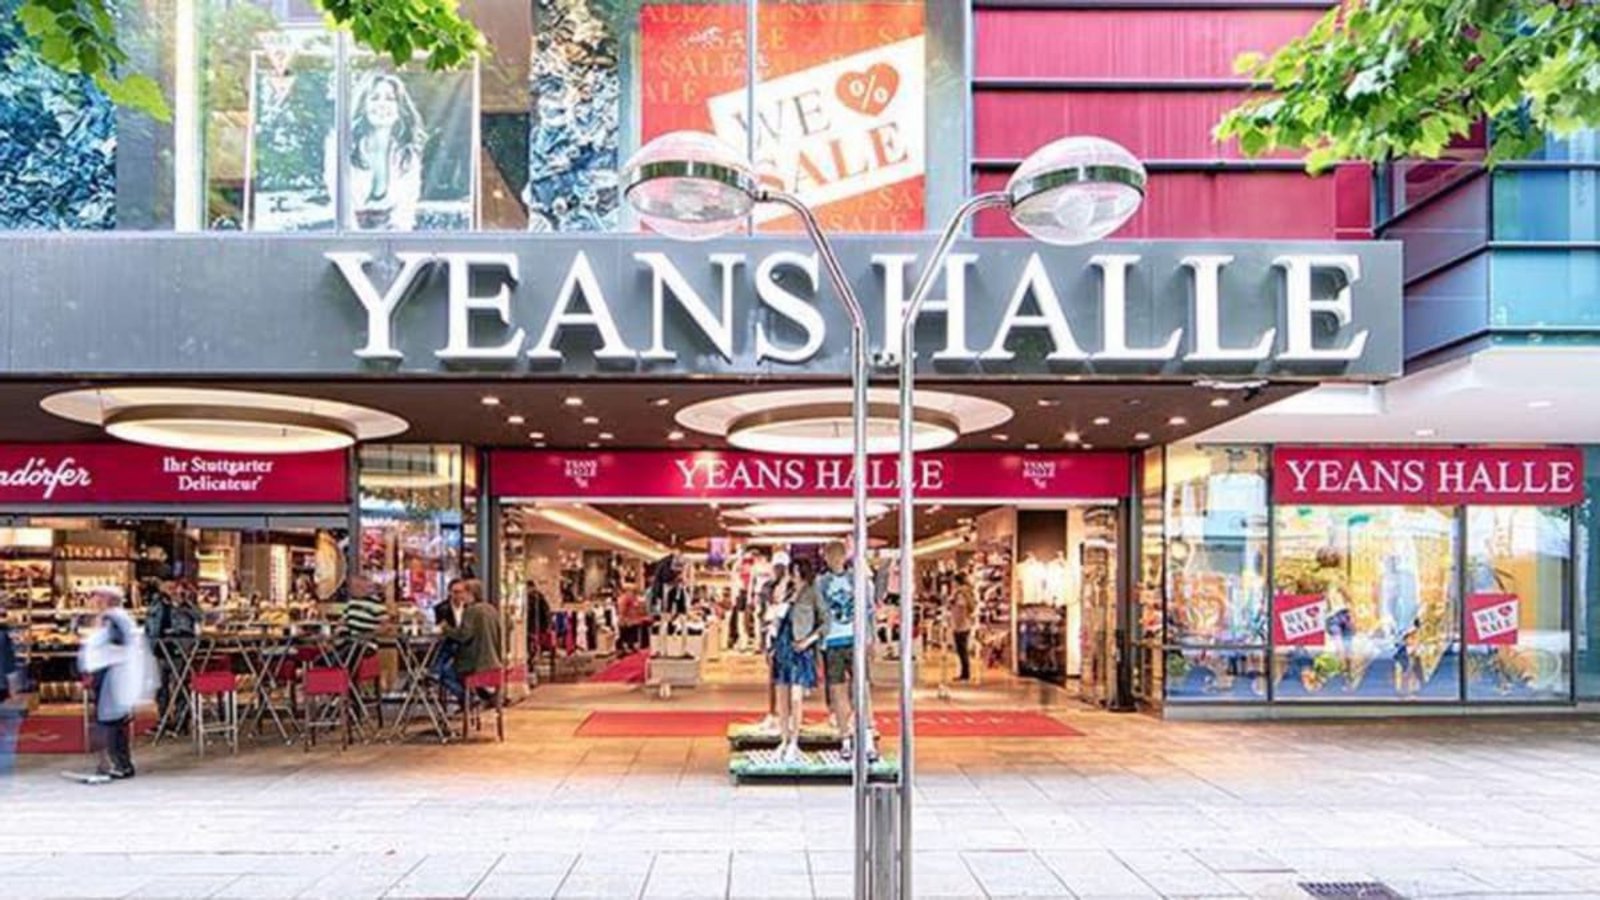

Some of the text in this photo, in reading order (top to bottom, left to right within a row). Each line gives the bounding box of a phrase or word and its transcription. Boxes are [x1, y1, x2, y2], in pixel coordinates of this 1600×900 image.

[735, 86, 830, 148] WE
[746, 120, 911, 194] SALE
[326, 251, 1368, 362] YEANS HALLE
[162, 457, 274, 477] Ihr Stuttgarter
[675, 459, 804, 490] YEANS
[1286, 460, 1574, 493] YEANS HALLE
